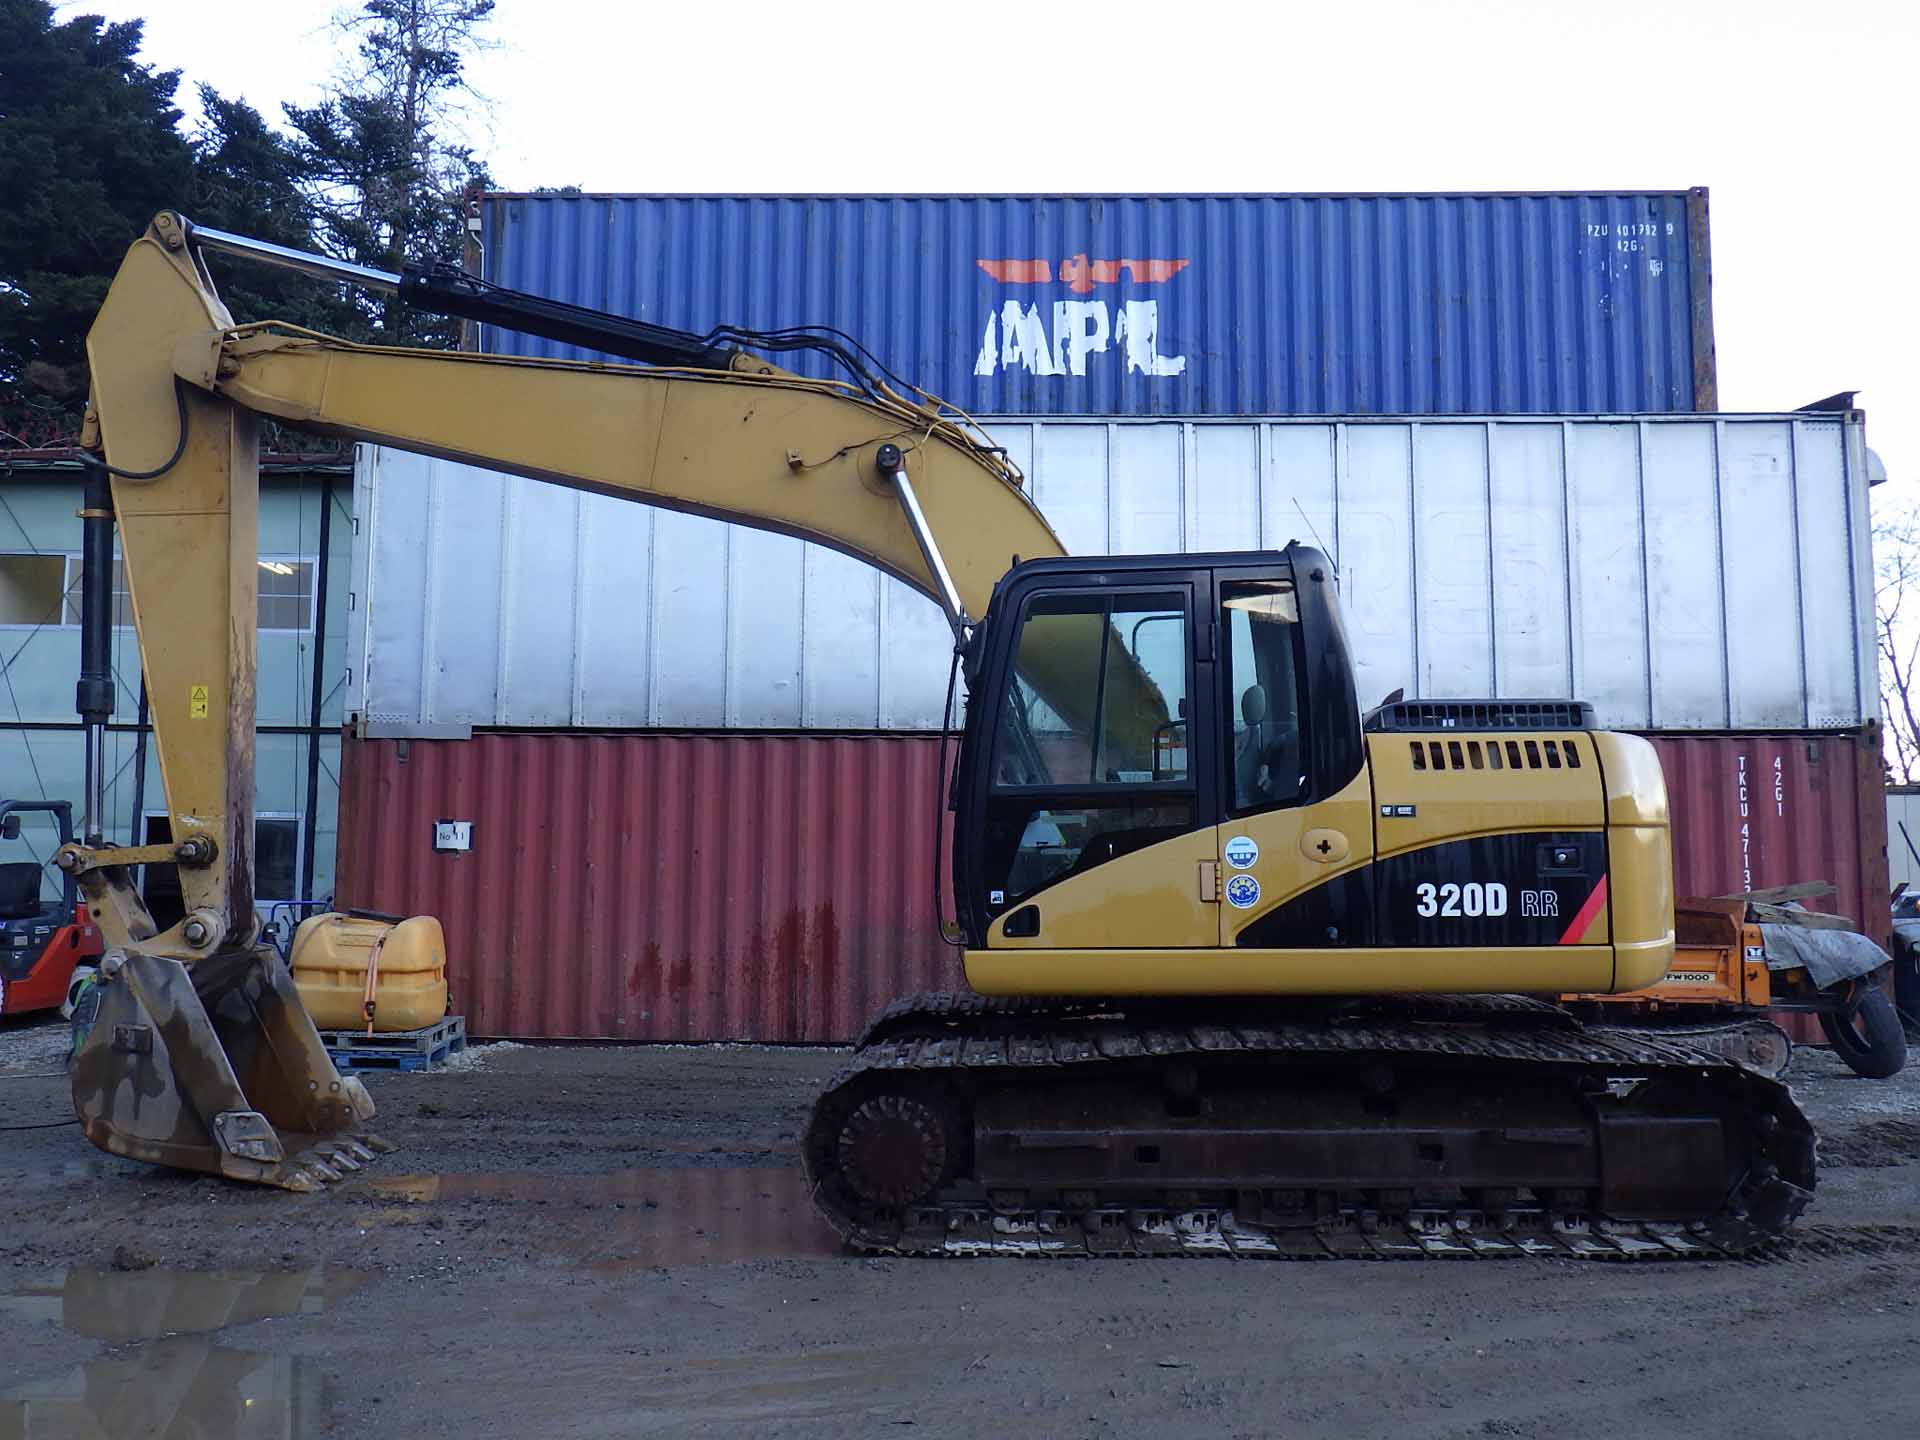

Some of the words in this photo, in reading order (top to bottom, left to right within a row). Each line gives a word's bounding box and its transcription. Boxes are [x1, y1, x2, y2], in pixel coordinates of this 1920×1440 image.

[1666, 223, 1673, 236] 9
[1738, 756, 1748, 817] TKCU
[1774, 756, 1783, 817] 42G1
[1416, 882, 1508, 918] 320D
[1521, 890, 1559, 917] RR
